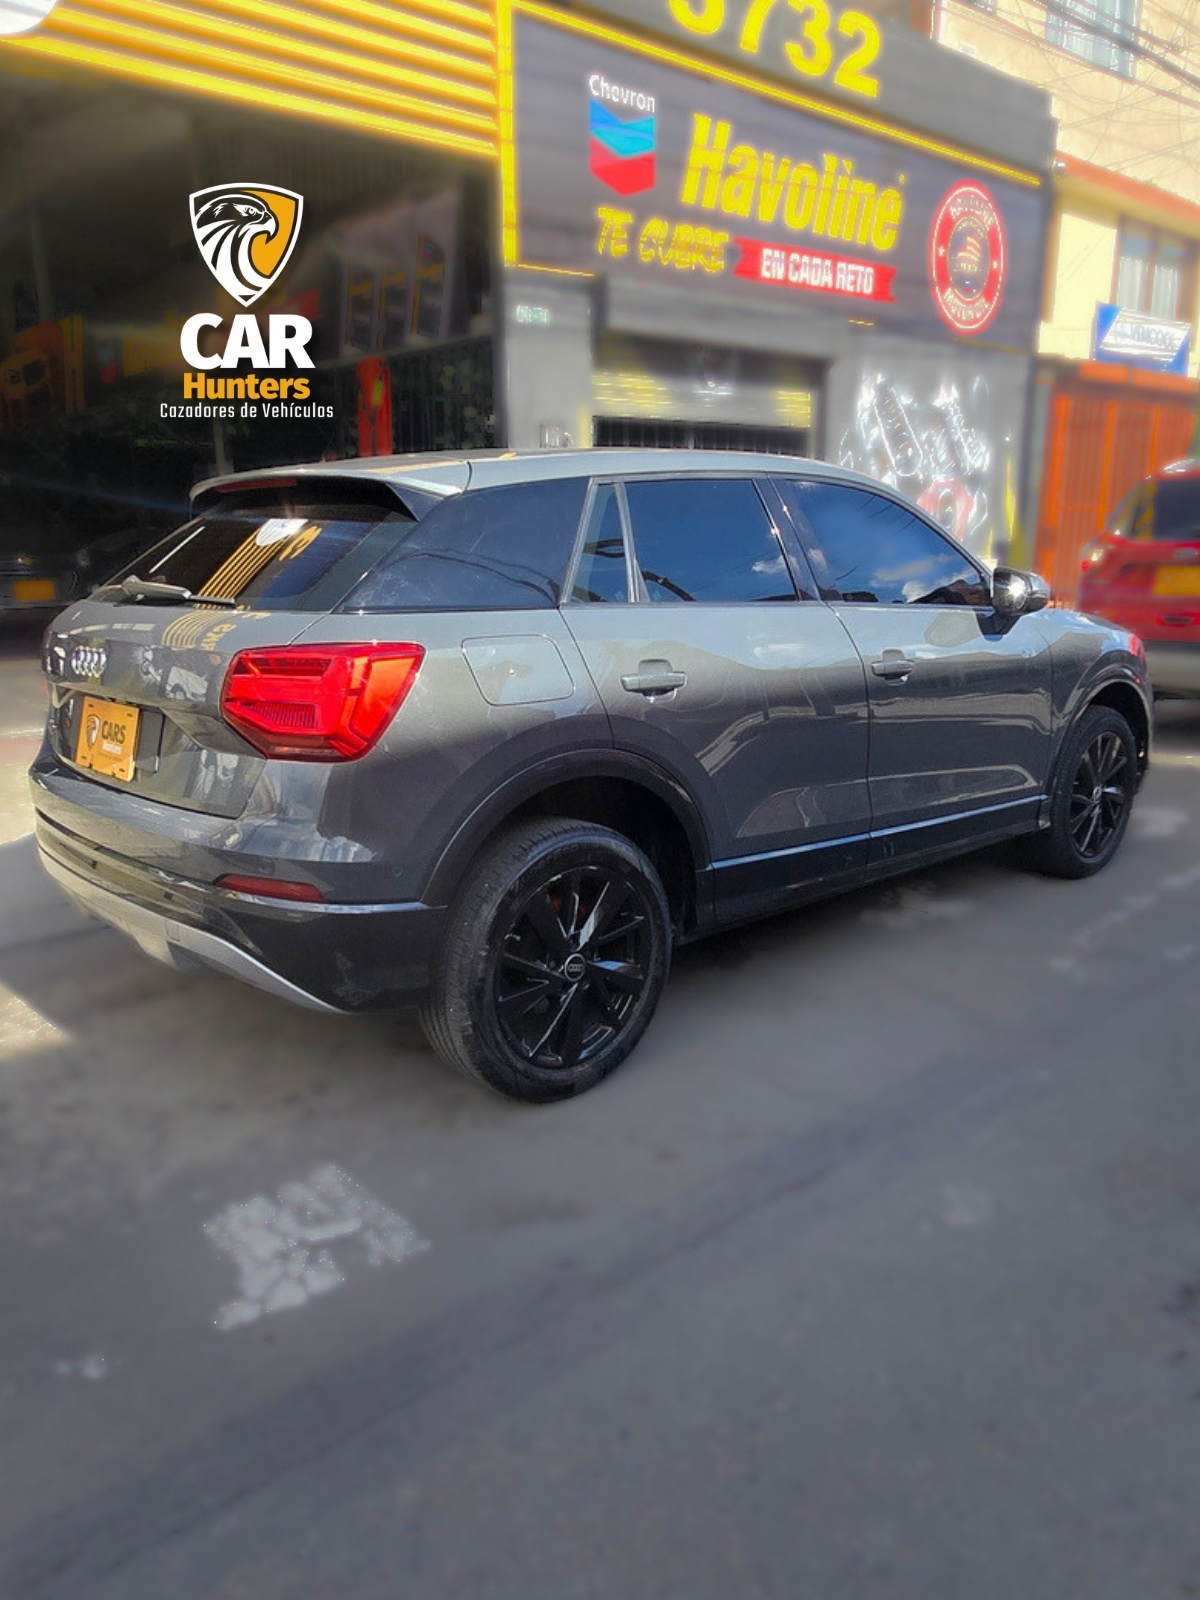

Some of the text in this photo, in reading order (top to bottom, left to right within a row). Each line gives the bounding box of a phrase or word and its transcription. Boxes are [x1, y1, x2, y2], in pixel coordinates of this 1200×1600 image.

[589, 74, 656, 113] Chevron
[682, 113, 904, 251] Havoline
[597, 207, 633, 258] TE
[761, 247, 874, 295] EN CADA RETO
[101, 720, 127, 745] CARS
